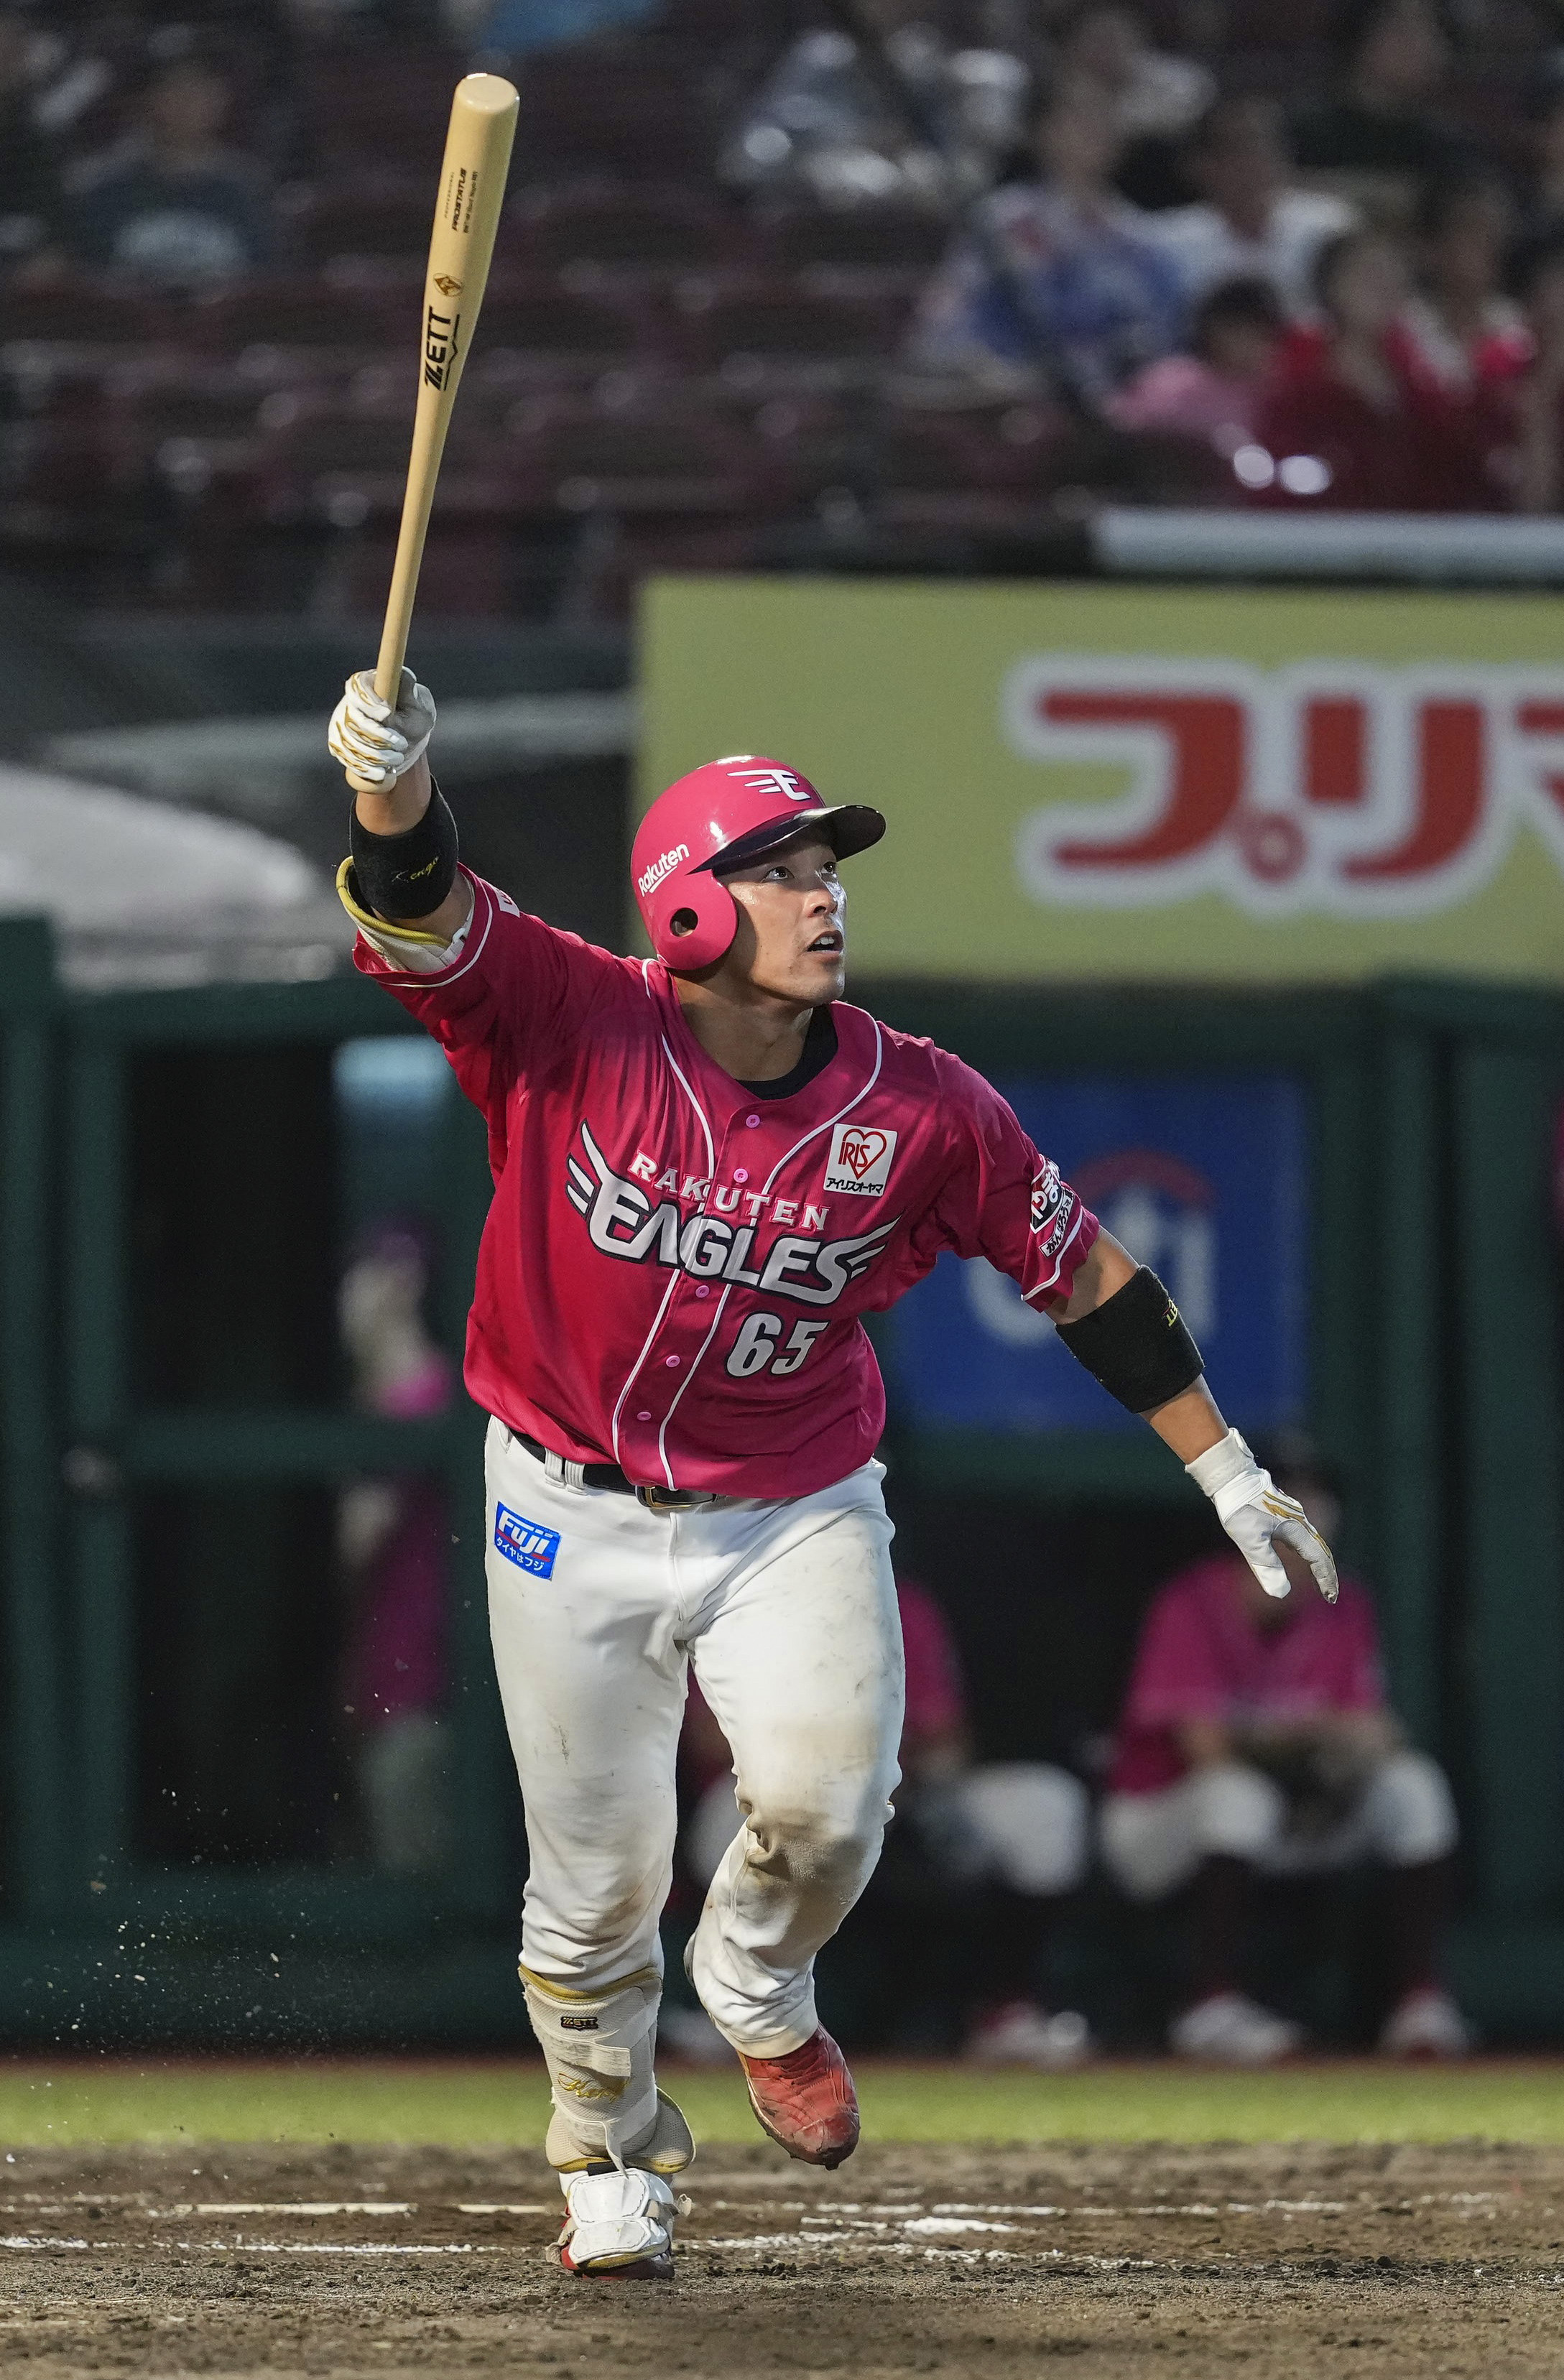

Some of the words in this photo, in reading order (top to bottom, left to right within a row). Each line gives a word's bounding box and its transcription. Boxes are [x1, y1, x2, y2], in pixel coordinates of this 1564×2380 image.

[425, 305, 451, 391] ZETT
[1038, 686, 1564, 887] プリ
[637, 843, 690, 897] Rakuten
[826, 1177, 884, 1194] アイリスオーヤマ
[838, 1141, 871, 1167] IRIS
[566, 1119, 902, 1308] EAGLES
[629, 1149, 830, 1231] RAKUTEN
[726, 1310, 830, 1378] 65
[496, 1537, 545, 1571] タイヤはフジ
